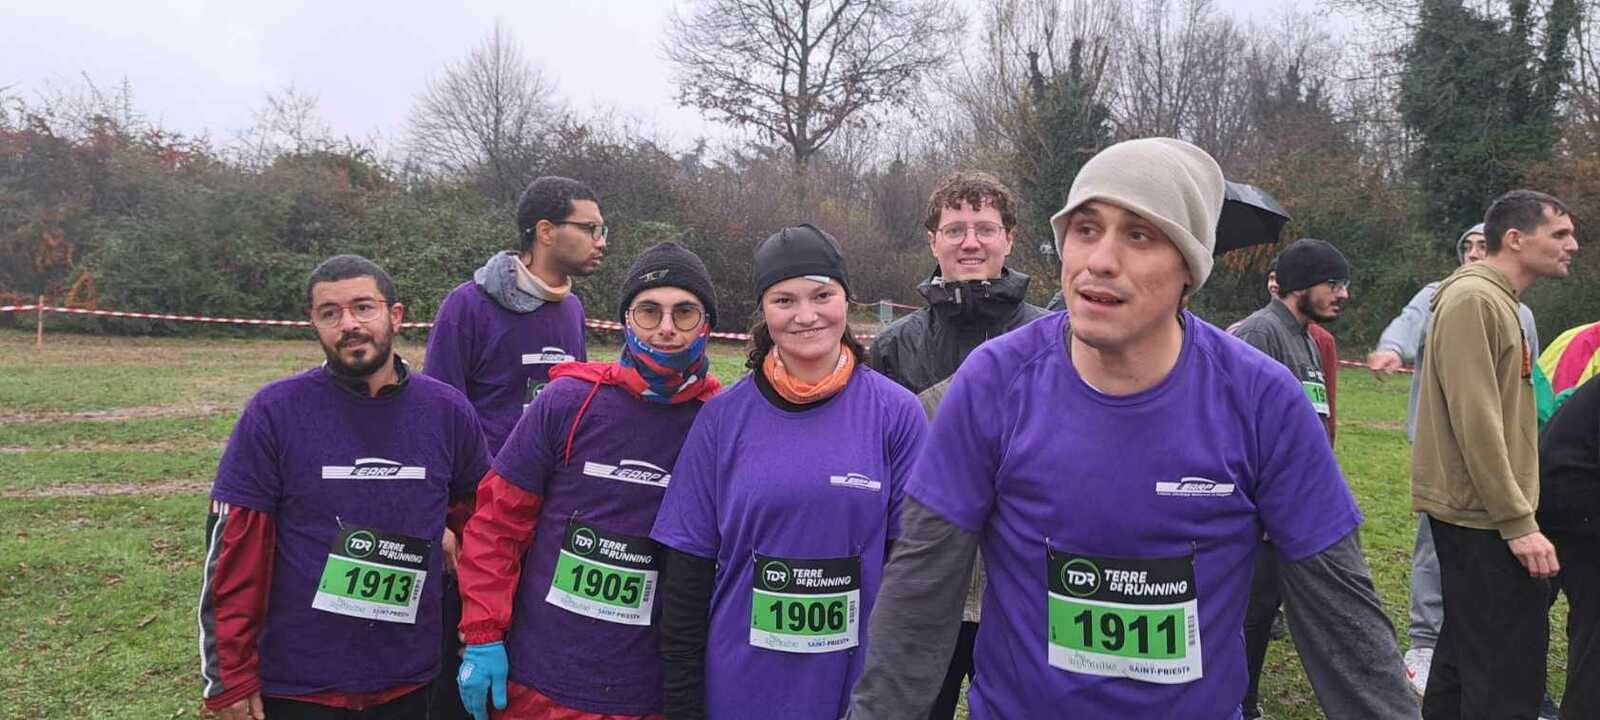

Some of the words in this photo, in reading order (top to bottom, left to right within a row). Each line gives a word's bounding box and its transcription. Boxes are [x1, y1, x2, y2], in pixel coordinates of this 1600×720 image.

[350, 537, 372, 551] TDR
[378, 540, 405, 551] TERRE
[574, 535, 594, 549] TDR
[599, 538, 627, 550] TERRE
[379, 549, 389, 557] DE
[388, 550, 423, 564] RUNNING
[608, 550, 652, 564] RUNNING
[766, 570, 787, 582] TDR
[792, 568, 823, 579] TERRE
[1067, 570, 1096, 587] TDR
[1104, 569, 1147, 582] TERRE
[344, 567, 412, 603] 1913
[571, 564, 641, 604] 1905
[806, 575, 852, 587] RUNNING
[1109, 582, 1123, 592] DE
[1123, 580, 1188, 596] RUNNING
[769, 600, 844, 632] 1906
[1074, 609, 1177, 655] 1911
[1129, 665, 1187, 676] SAINT-PRIEST
